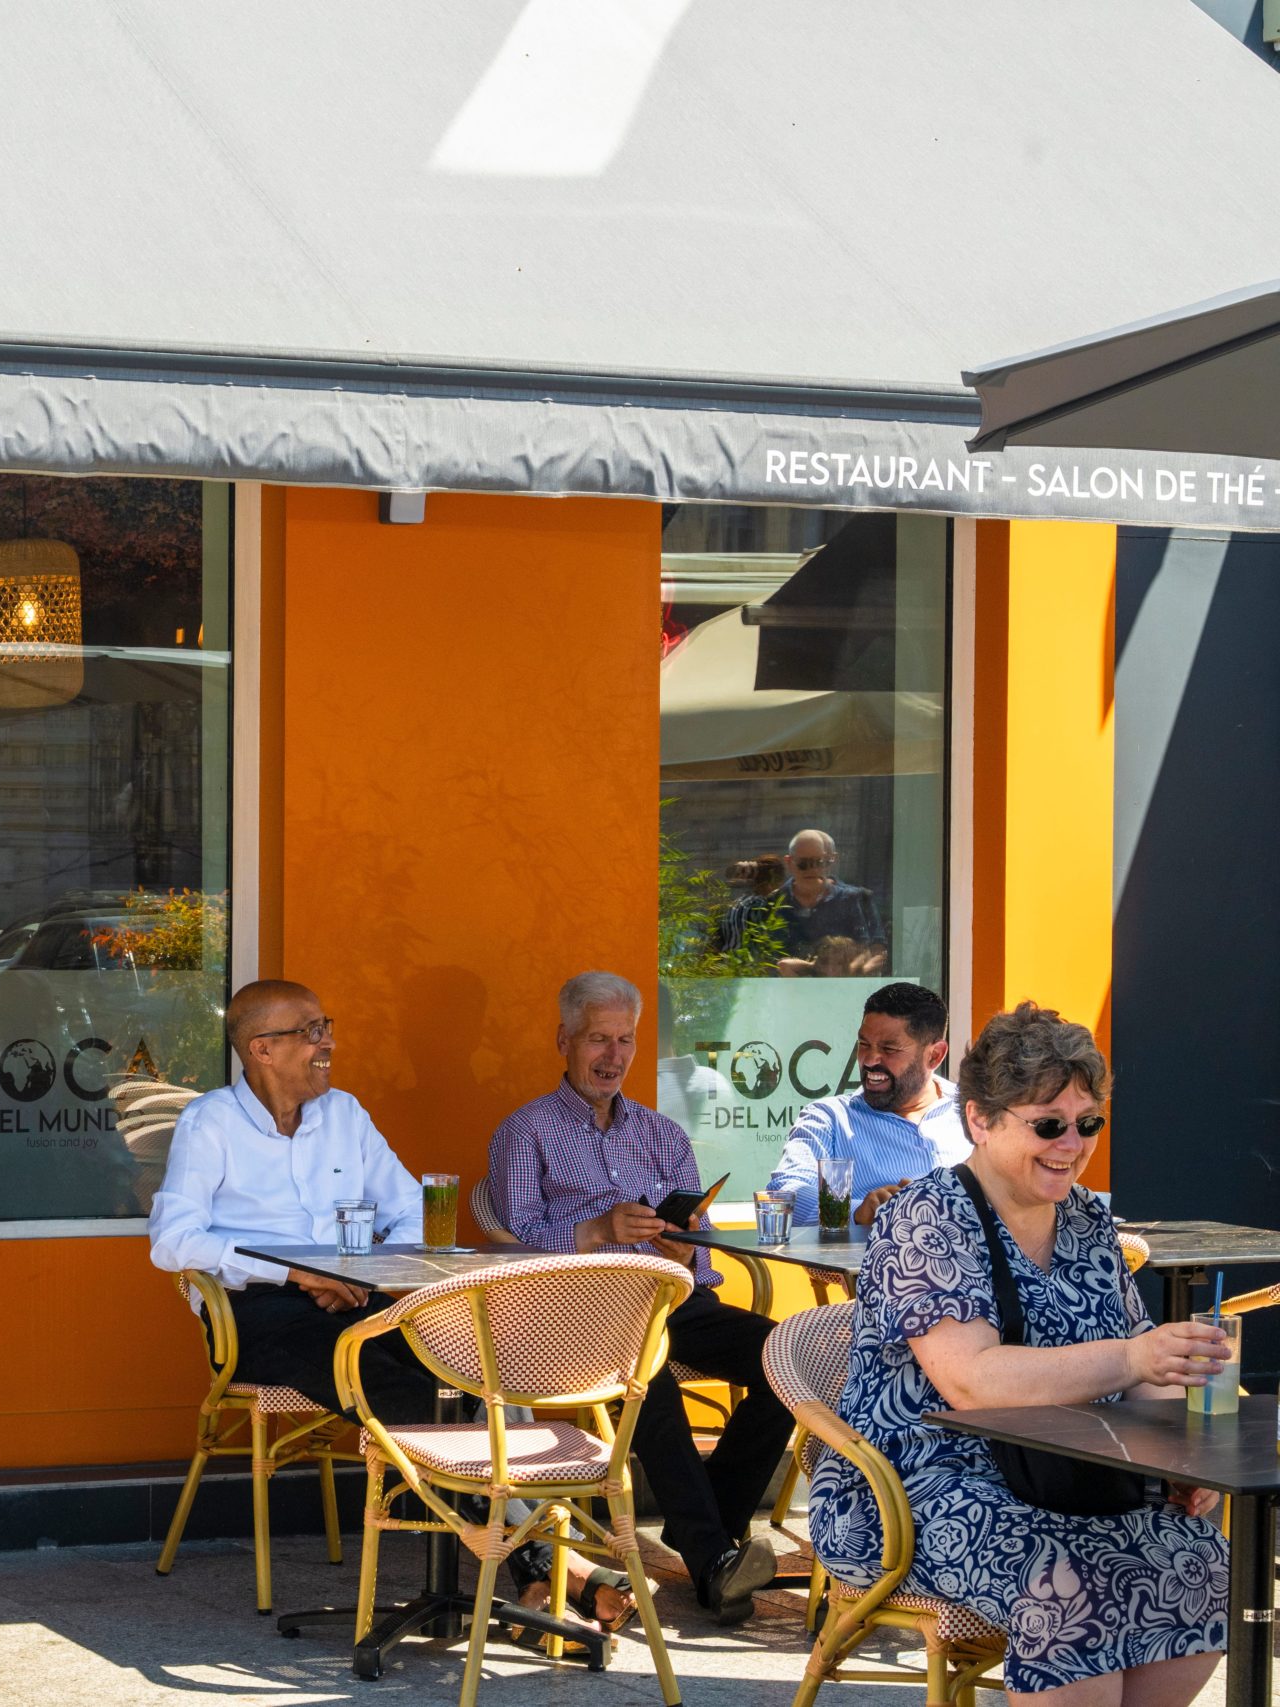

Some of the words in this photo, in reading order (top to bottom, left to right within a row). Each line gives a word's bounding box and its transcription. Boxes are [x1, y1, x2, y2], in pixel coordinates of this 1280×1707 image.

[765, 449, 991, 493] RESTAURANT
[1027, 463, 1144, 501] SALON
[1155, 469, 1197, 503] DE
[1206, 465, 1265, 506] THÉ
[714, 1106, 759, 1129] DEL
[26, 1137, 57, 1149] fusion
[60, 1136, 81, 1149] and
[82, 1137, 99, 1150] joy
[756, 1133, 782, 1143] fusion
